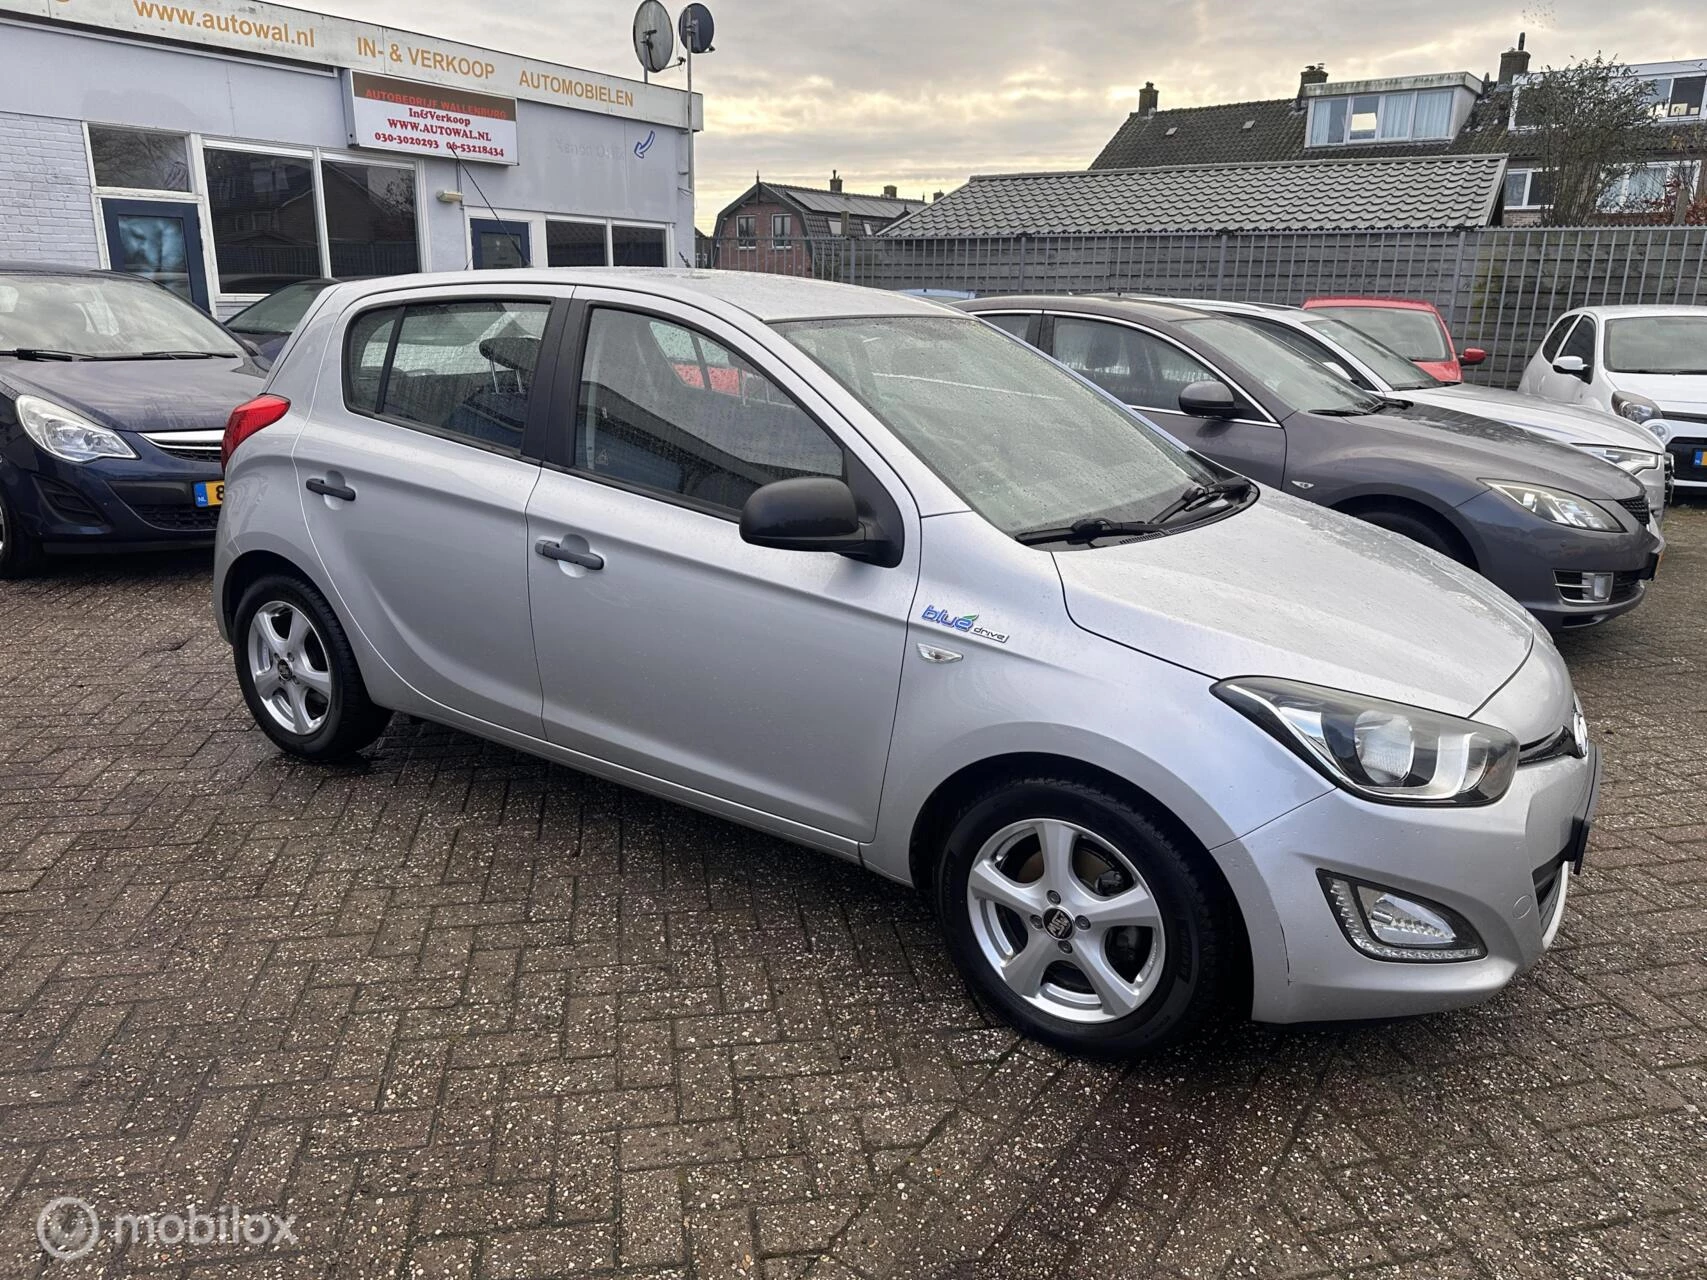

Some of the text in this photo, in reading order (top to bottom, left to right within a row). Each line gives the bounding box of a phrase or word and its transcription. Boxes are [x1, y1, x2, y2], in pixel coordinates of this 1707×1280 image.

[132, 0, 315, 48] www.autowal.nl
[357, 37, 634, 108] IN- & VERKOOP AUTOMOBIELEN
[365, 88, 507, 120] AUTOBEDRIJF WALLENBURG
[408, 107, 471, 127] In&Verkoop
[374, 132, 505, 158] 030-3020293 06-53218434
[387, 118, 492, 142] WWW.AUTOWAL.NL
[921, 604, 1007, 642] blue drive
